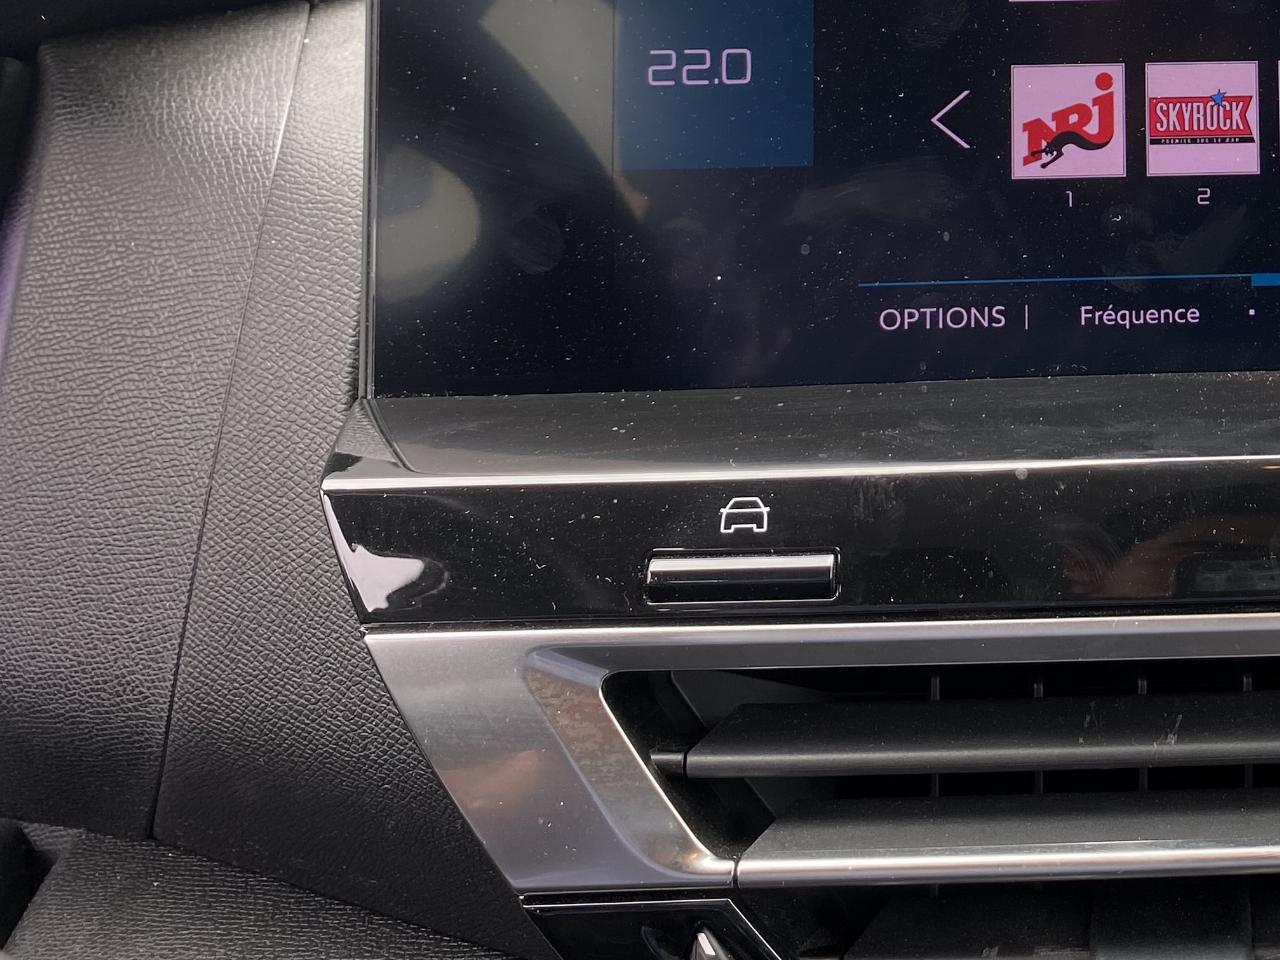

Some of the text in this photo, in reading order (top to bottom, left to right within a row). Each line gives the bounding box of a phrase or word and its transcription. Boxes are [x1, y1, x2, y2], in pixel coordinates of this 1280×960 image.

[648, 47, 752, 86] 22.0
[1156, 100, 1245, 133] SKYROCK
[1065, 190, 1074, 208] 1
[1196, 187, 1211, 205] 2
[879, 306, 1006, 331] OPTIONS
[1080, 304, 1201, 329] Fréquence
